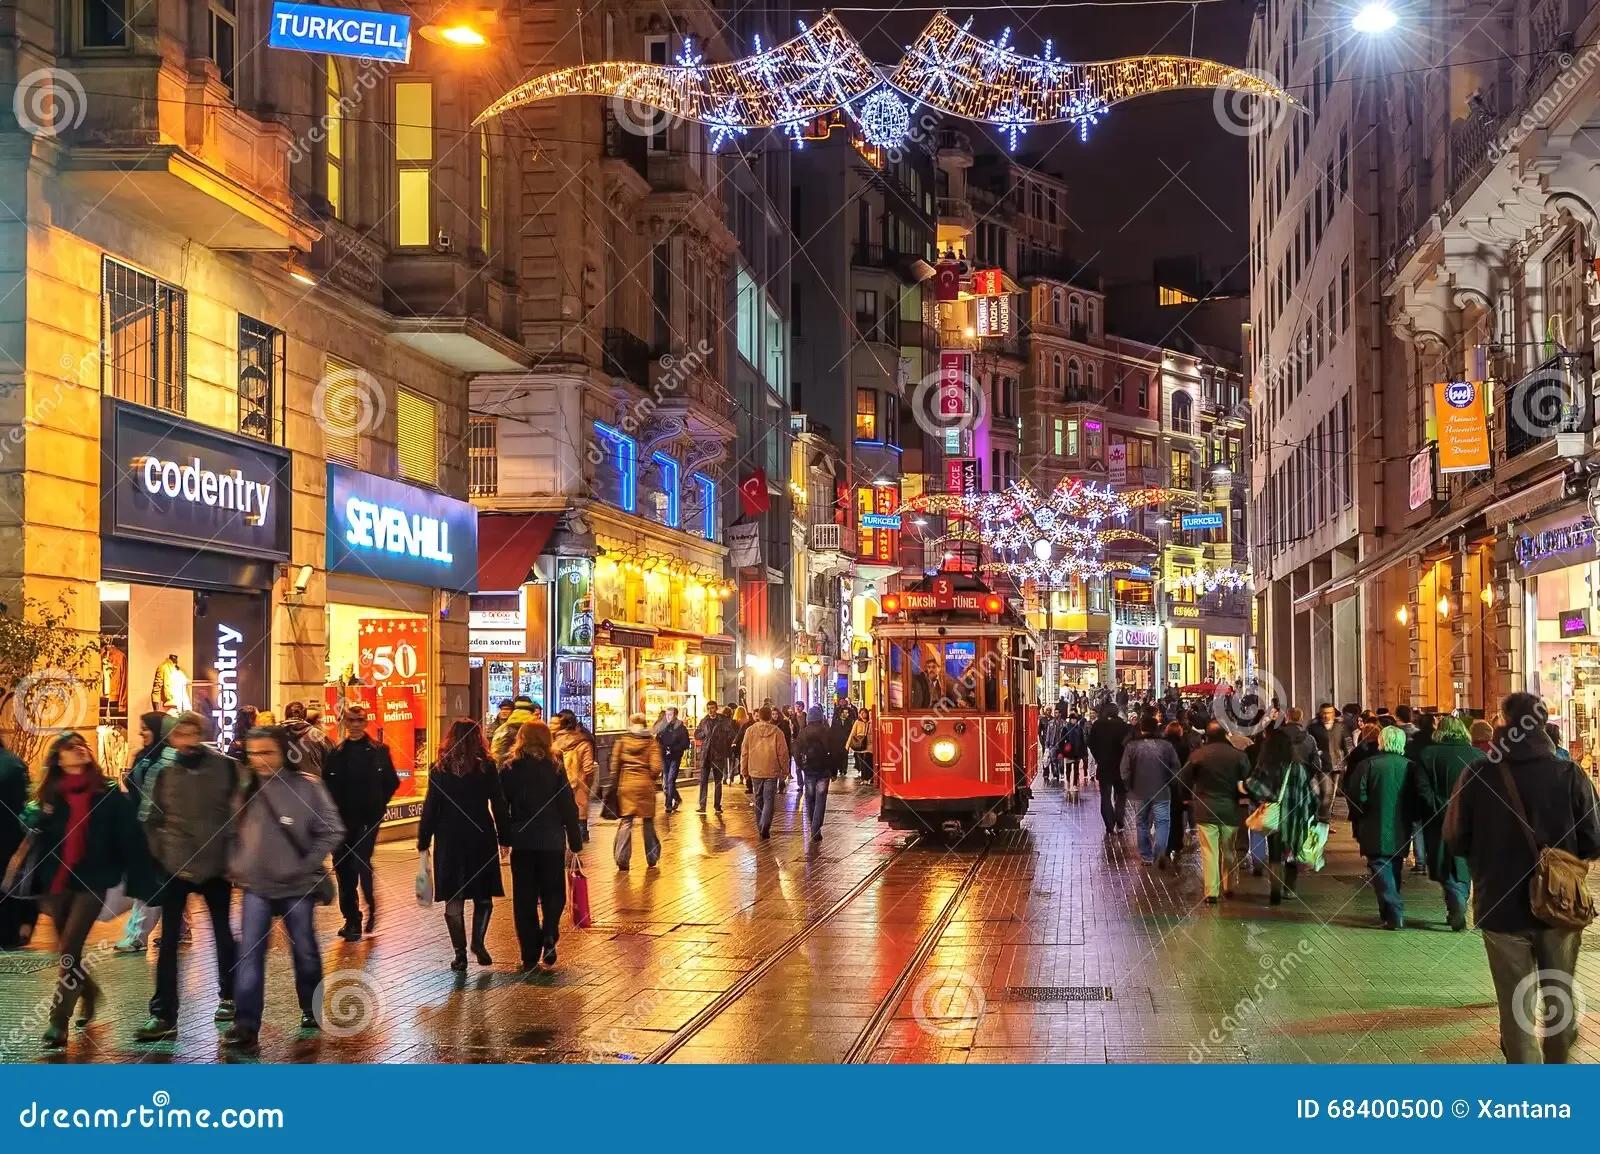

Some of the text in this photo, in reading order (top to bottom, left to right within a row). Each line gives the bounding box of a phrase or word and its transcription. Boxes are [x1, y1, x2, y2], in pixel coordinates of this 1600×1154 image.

[277, 13, 403, 48] TURKCELL
[946, 357, 958, 410] GÖKDİL
[144, 456, 271, 527] codentry
[864, 516, 900, 525] TURKCELL
[1184, 516, 1222, 526] TURKCELL
[346, 497, 453, 563] SEVENHILL
[939, 581, 947, 594] 3
[952, 596, 980, 609] TÜNEL
[384, 711, 413, 722] indirim
[995, 721, 1008, 734] 410
